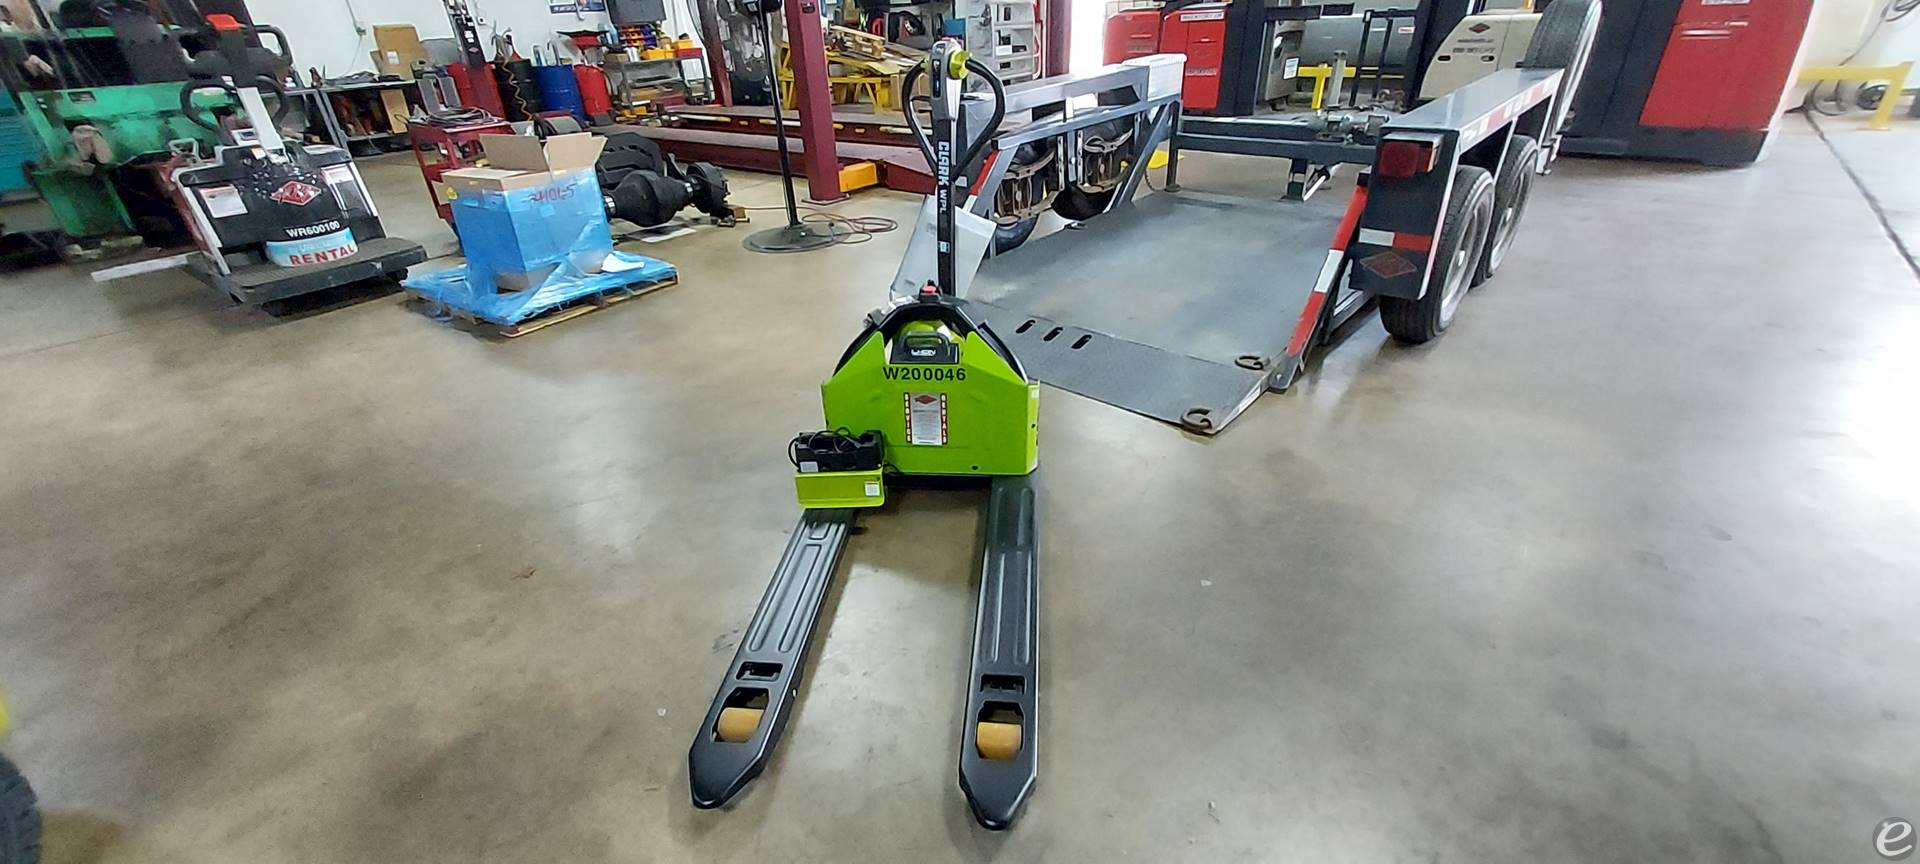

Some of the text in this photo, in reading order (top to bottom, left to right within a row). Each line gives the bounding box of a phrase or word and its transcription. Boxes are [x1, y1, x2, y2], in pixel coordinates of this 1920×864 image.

[938, 141, 950, 214] CLARK WPL
[285, 220, 341, 239] WR600100
[289, 244, 355, 265] RENTAL
[882, 366, 967, 382] W200046
